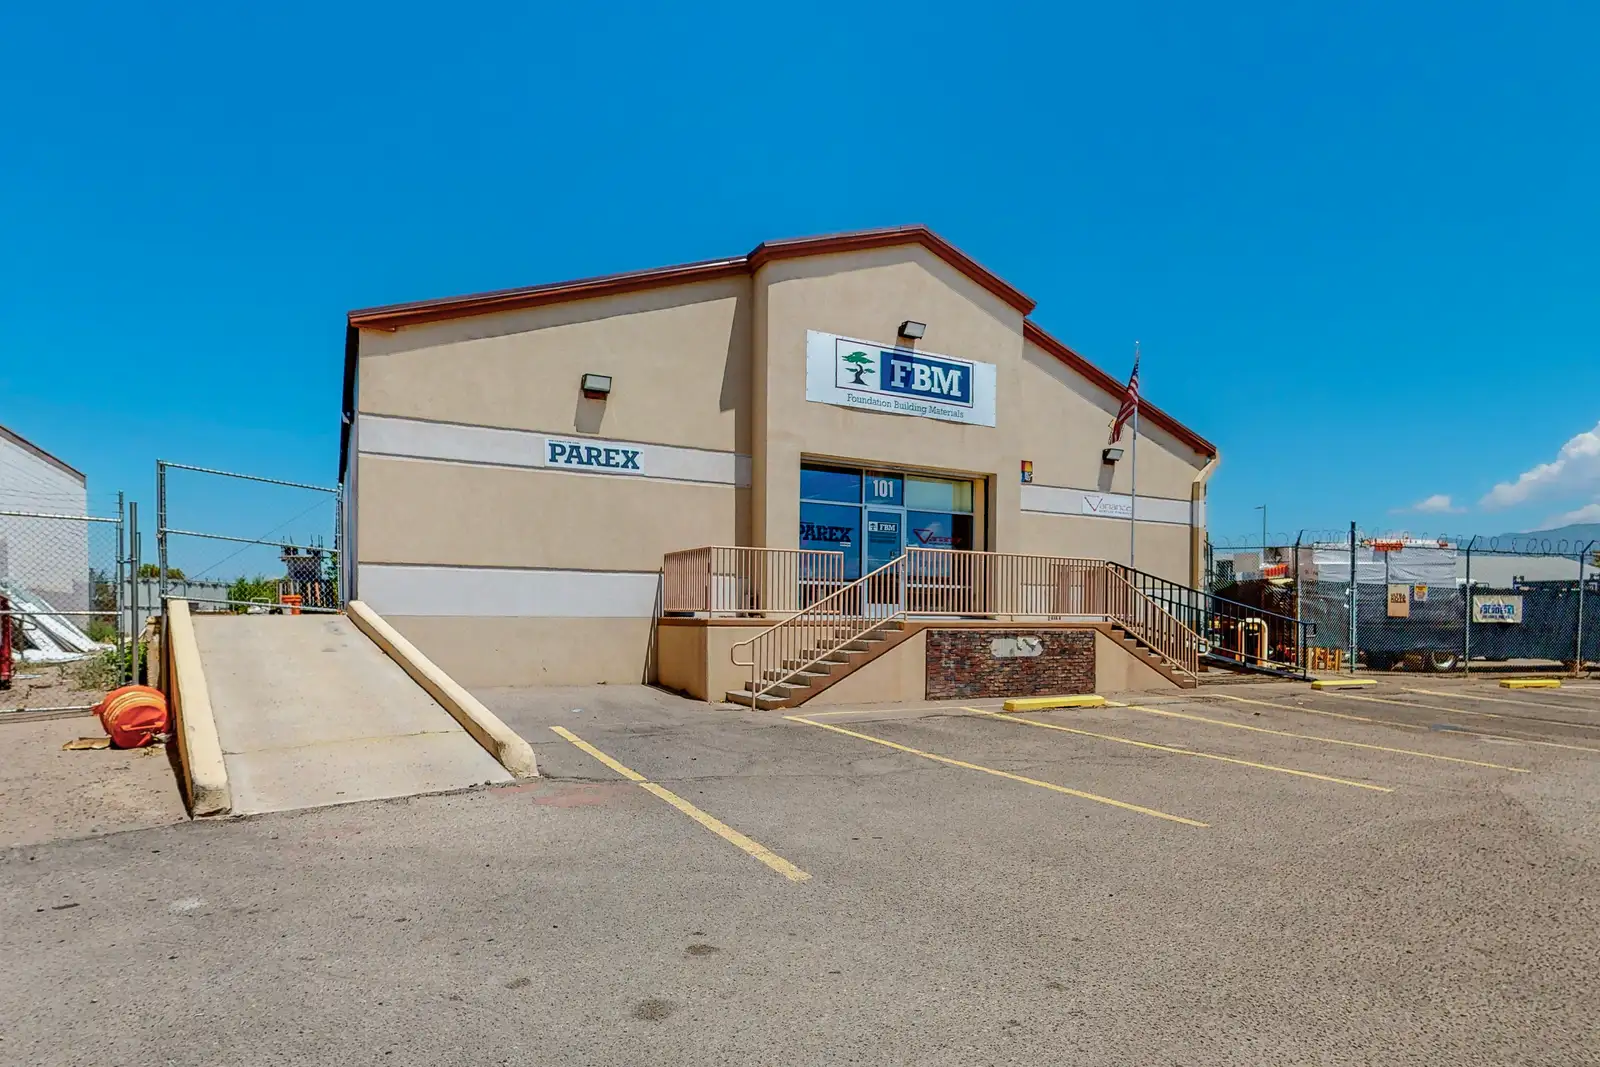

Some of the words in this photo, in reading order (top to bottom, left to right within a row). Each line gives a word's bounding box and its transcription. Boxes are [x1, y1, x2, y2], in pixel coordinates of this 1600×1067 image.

[890, 359, 962, 398] FBM
[847, 393, 892, 408] Foundation
[893, 401, 927, 415] Building
[928, 405, 964, 419] Materials
[548, 442, 640, 470] PAREX
[873, 479, 894, 498] 101
[879, 523, 896, 532] FBM
